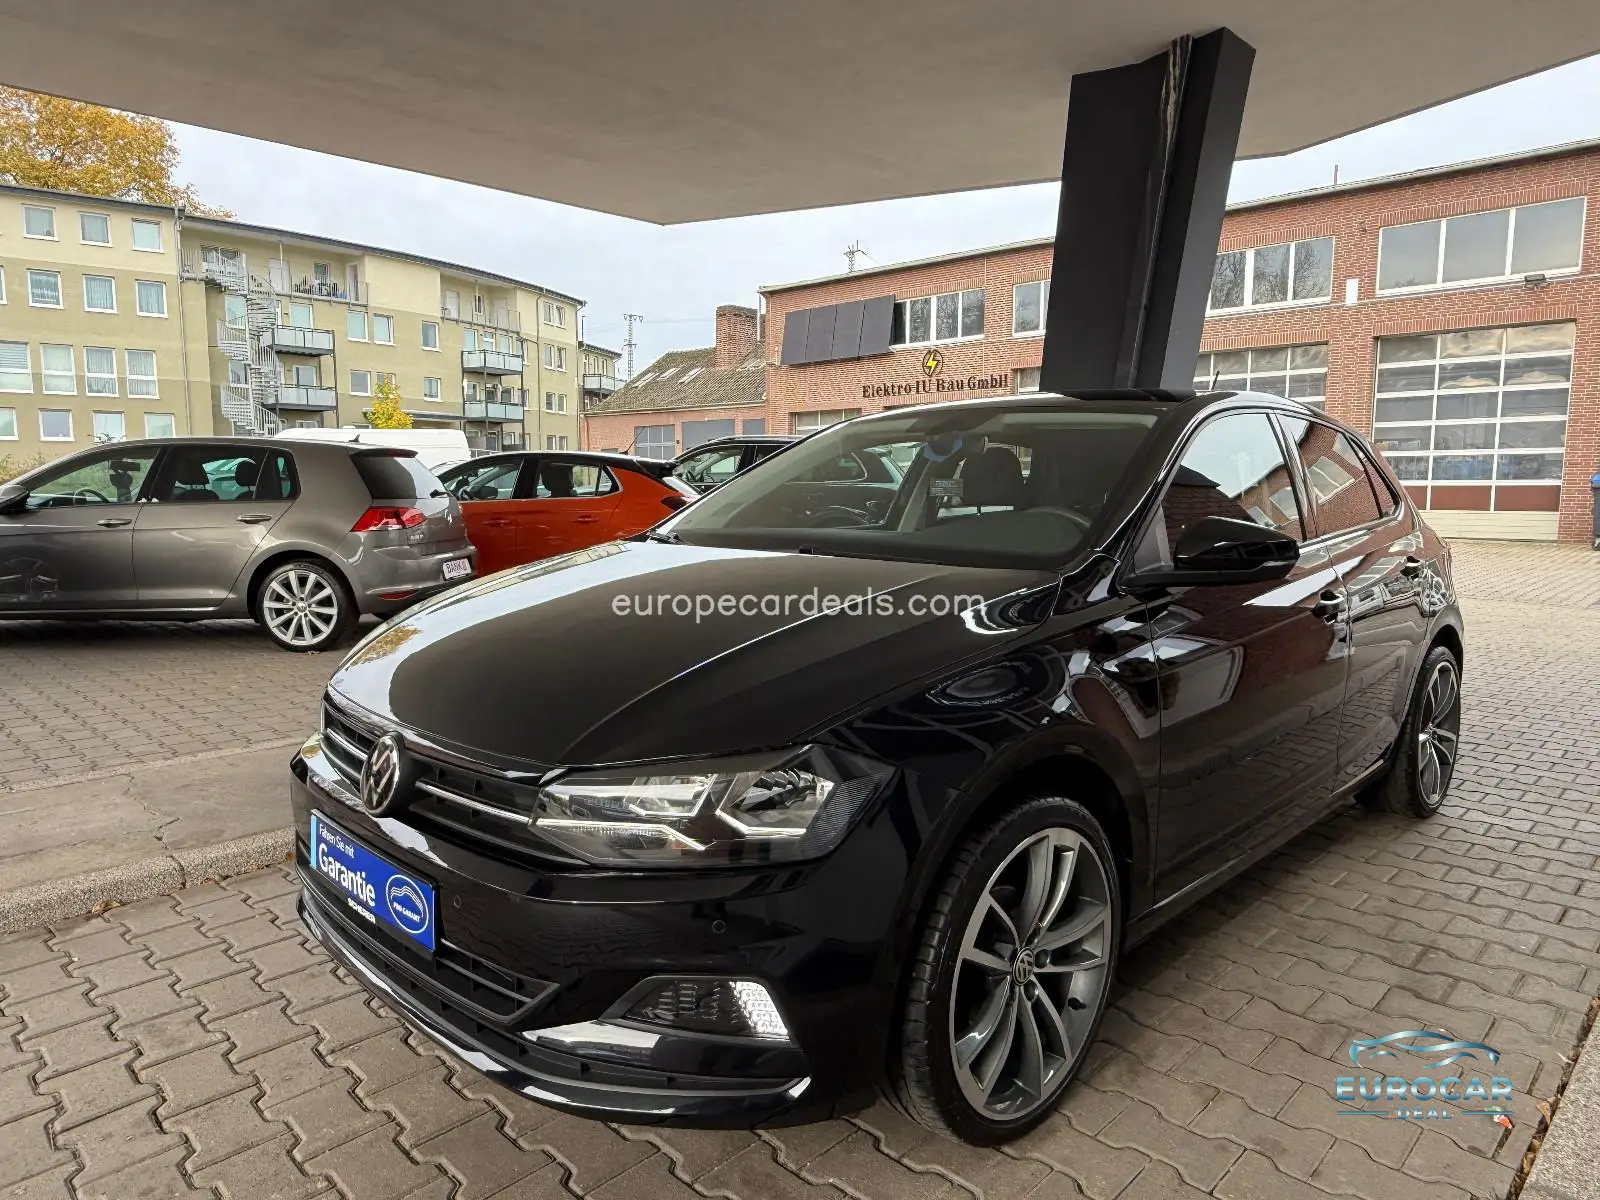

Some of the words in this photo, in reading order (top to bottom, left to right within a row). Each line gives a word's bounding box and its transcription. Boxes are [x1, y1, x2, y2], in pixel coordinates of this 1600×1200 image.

[862, 381, 912, 398] Elektro
[936, 378, 965, 393] Bau
[967, 374, 1009, 391] GmbH
[319, 823, 336, 845] Fahren
[335, 835, 345, 852] Sie
[345, 844, 355, 859] mit
[318, 842, 376, 907] Garantie
